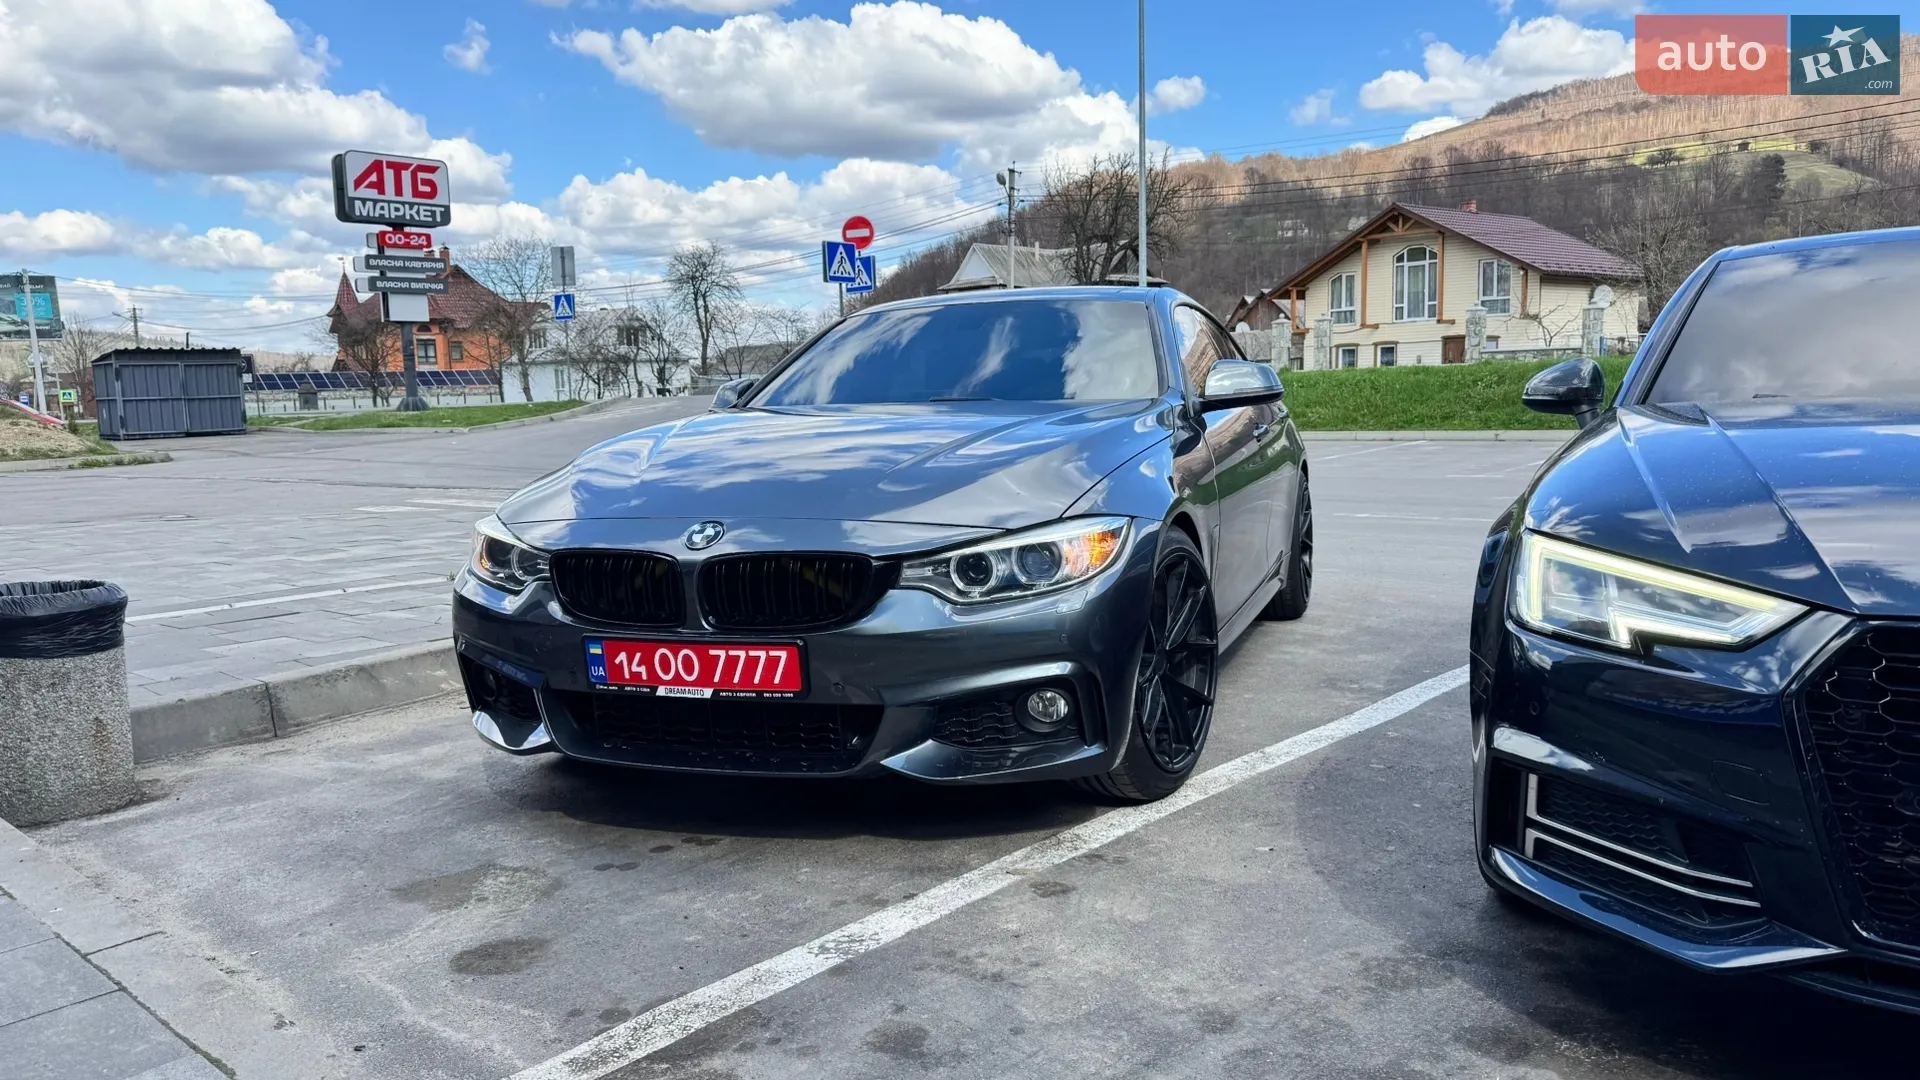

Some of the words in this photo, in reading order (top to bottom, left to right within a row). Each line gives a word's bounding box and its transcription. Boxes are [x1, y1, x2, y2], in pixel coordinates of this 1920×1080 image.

[353, 159, 441, 200] АТБ
[354, 200, 445, 222] МАРКЕТ
[385, 233, 428, 246] 00-24
[369, 258, 404, 267] ВЛАСНА
[376, 281, 409, 289] ВЛАСНА
[410, 282, 444, 290] ВИПІЧКА
[591, 665, 606, 676] UA
[614, 651, 648, 680] 14
[709, 650, 788, 684] 7777
[687, 688, 705, 697] AUTO
